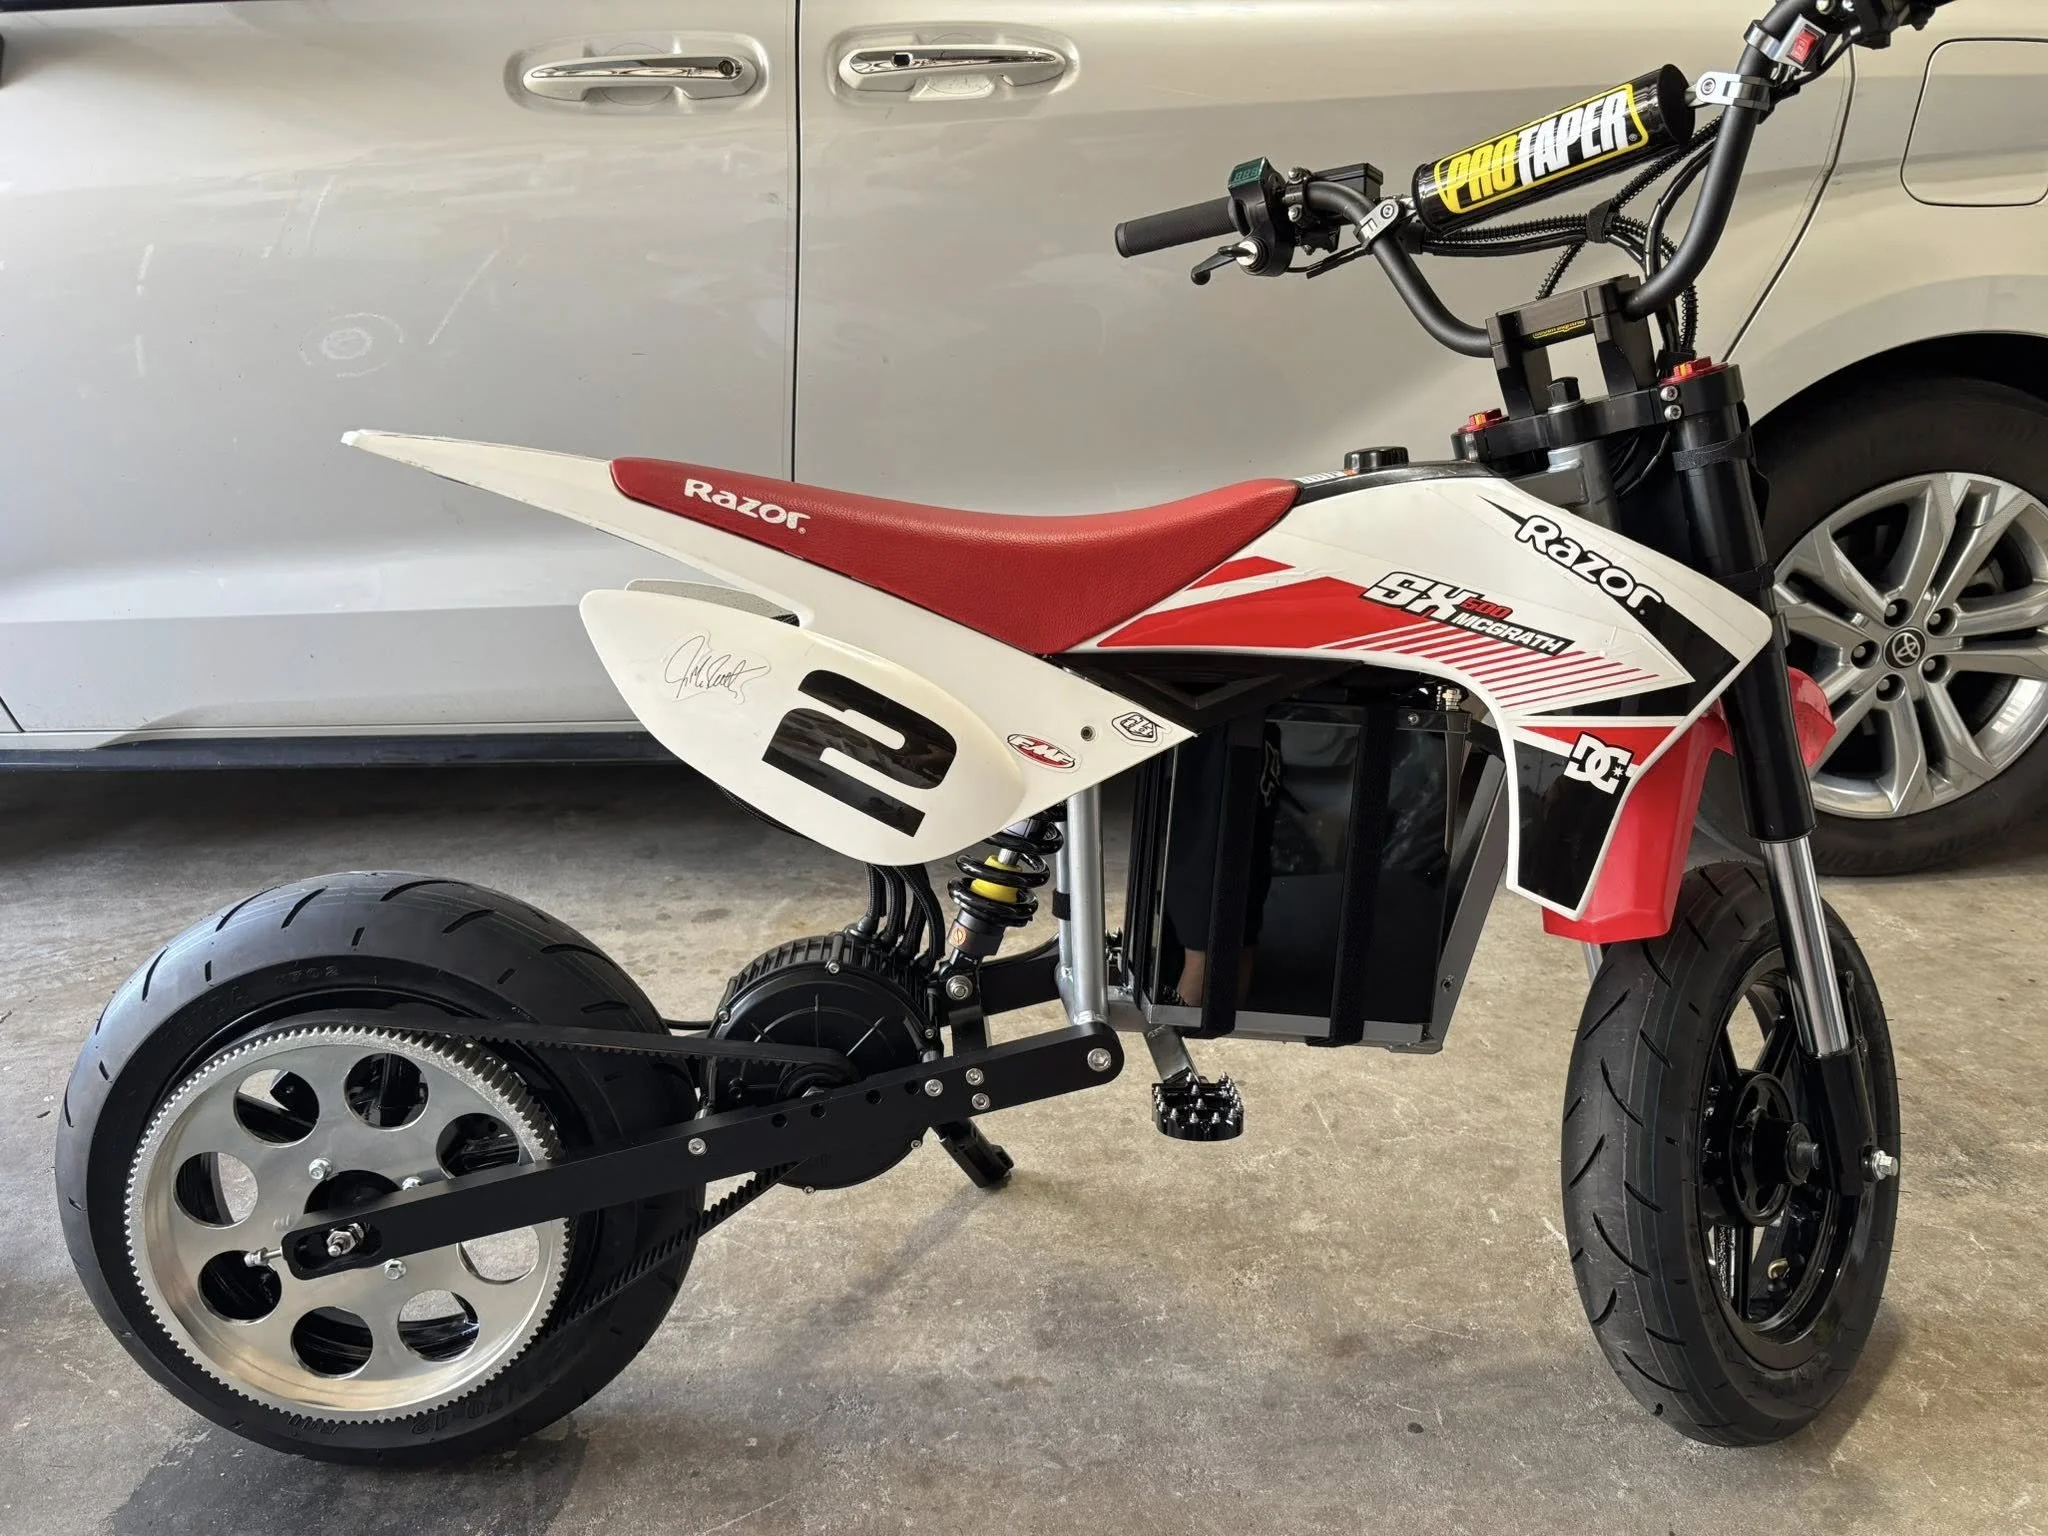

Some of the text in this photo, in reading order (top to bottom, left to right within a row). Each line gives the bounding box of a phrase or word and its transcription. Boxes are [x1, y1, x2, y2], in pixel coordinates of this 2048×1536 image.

[684, 478, 811, 531] Razor
[1515, 515, 1665, 609] Razor
[1359, 571, 1514, 623] SX 500
[1451, 611, 1566, 654] MCGRATH
[761, 669, 958, 838] 2
[1564, 732, 1633, 795] DC
